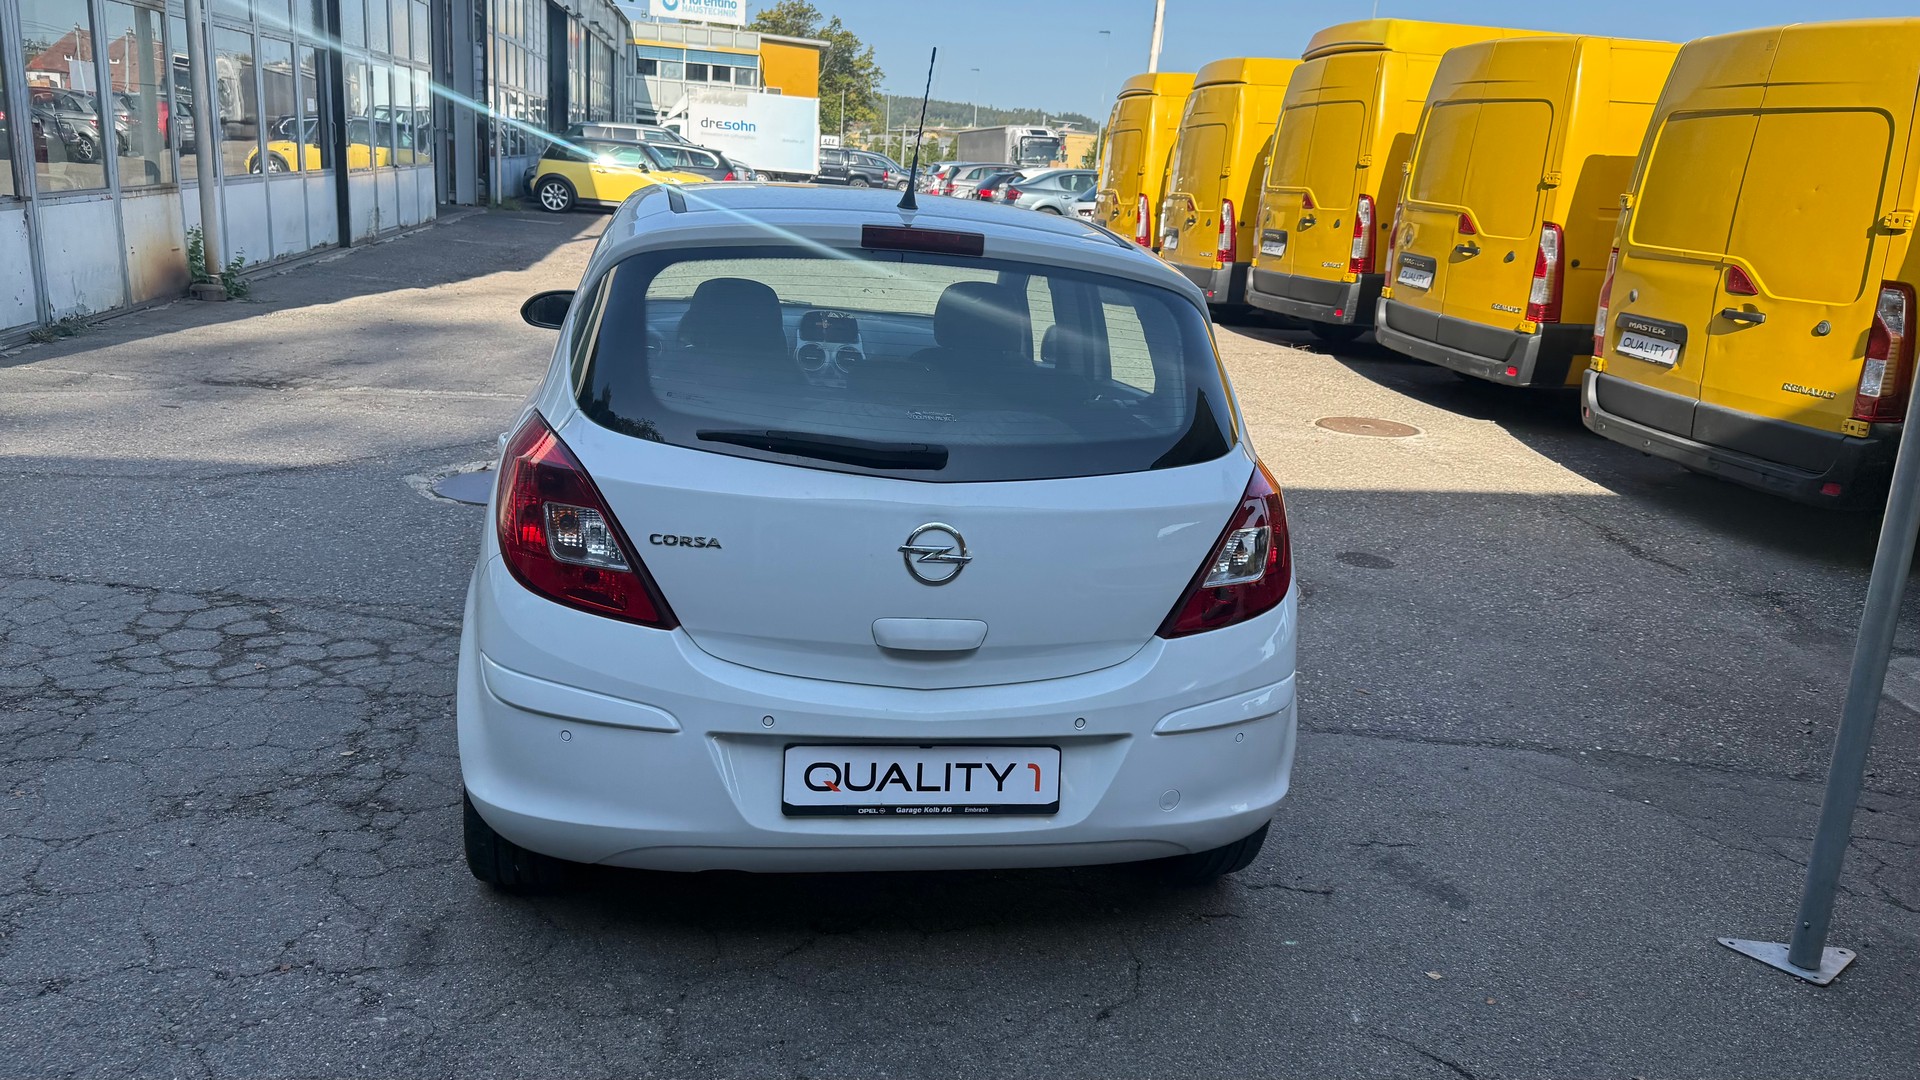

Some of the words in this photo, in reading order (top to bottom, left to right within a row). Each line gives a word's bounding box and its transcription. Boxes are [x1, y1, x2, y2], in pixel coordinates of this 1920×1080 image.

[682, 4, 737, 17] HAUSTECHNIK
[701, 117, 756, 132] dresohn
[1628, 321, 1666, 336] MASTER
[1623, 337, 1669, 357] QUALITY
[1781, 382, 1836, 400] RENAULT
[649, 533, 722, 549] CORSA
[803, 762, 1017, 792] QUALITY
[1027, 763, 1041, 792] 1
[896, 806, 922, 815] Garage
